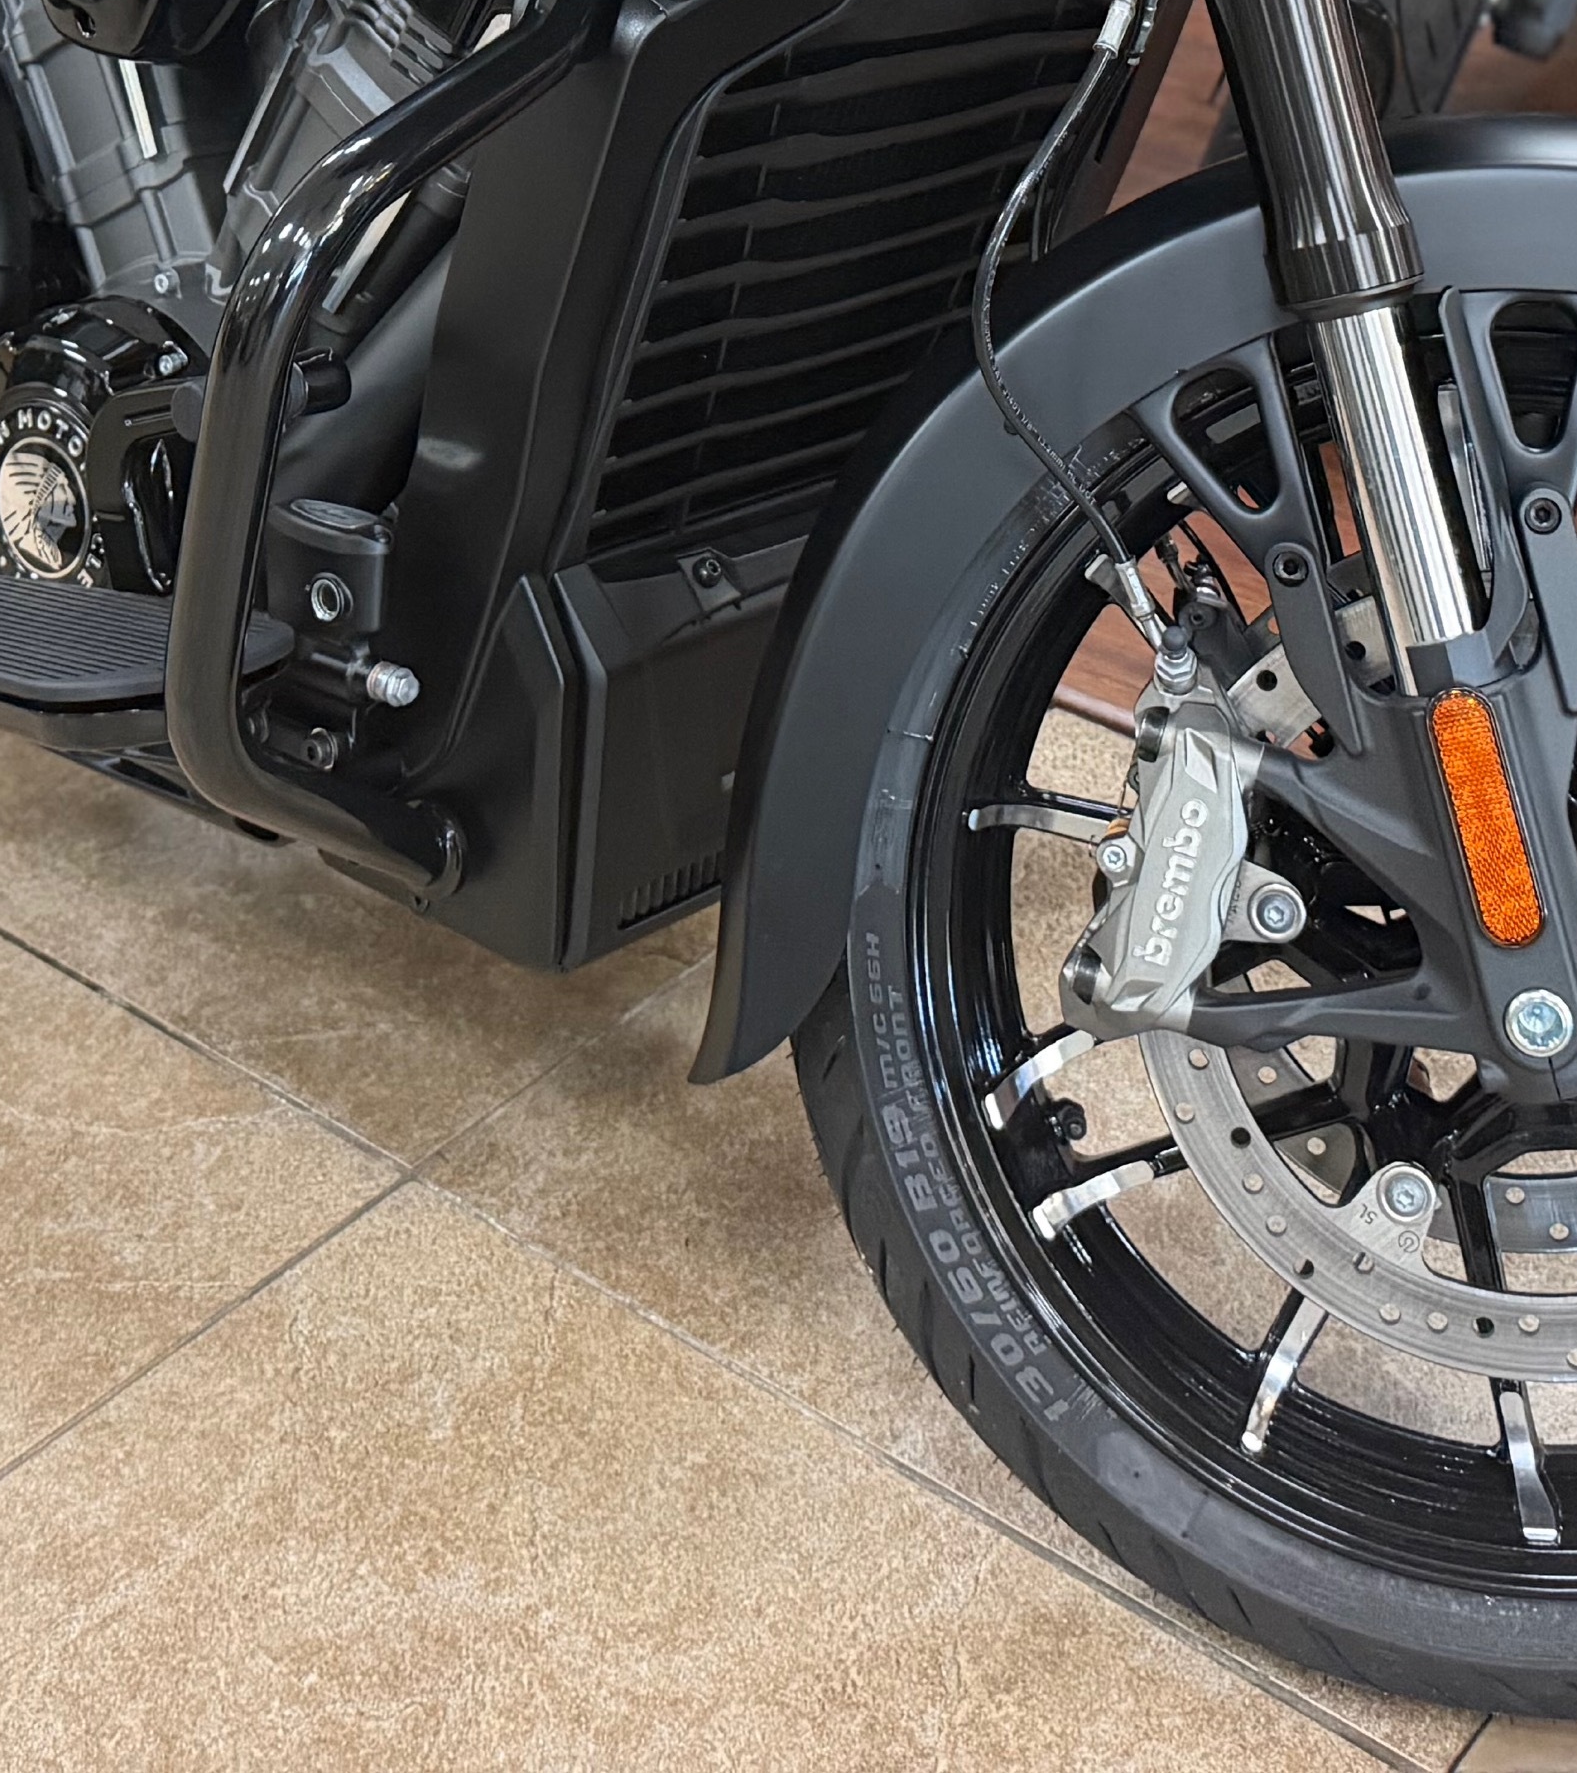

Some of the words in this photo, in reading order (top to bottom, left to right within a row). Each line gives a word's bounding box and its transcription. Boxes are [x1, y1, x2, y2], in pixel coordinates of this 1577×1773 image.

[1132, 796, 1210, 967] brembo
[919, 1131, 1050, 1358] REINFORCED
[928, 1228, 1071, 1423] 130/60
